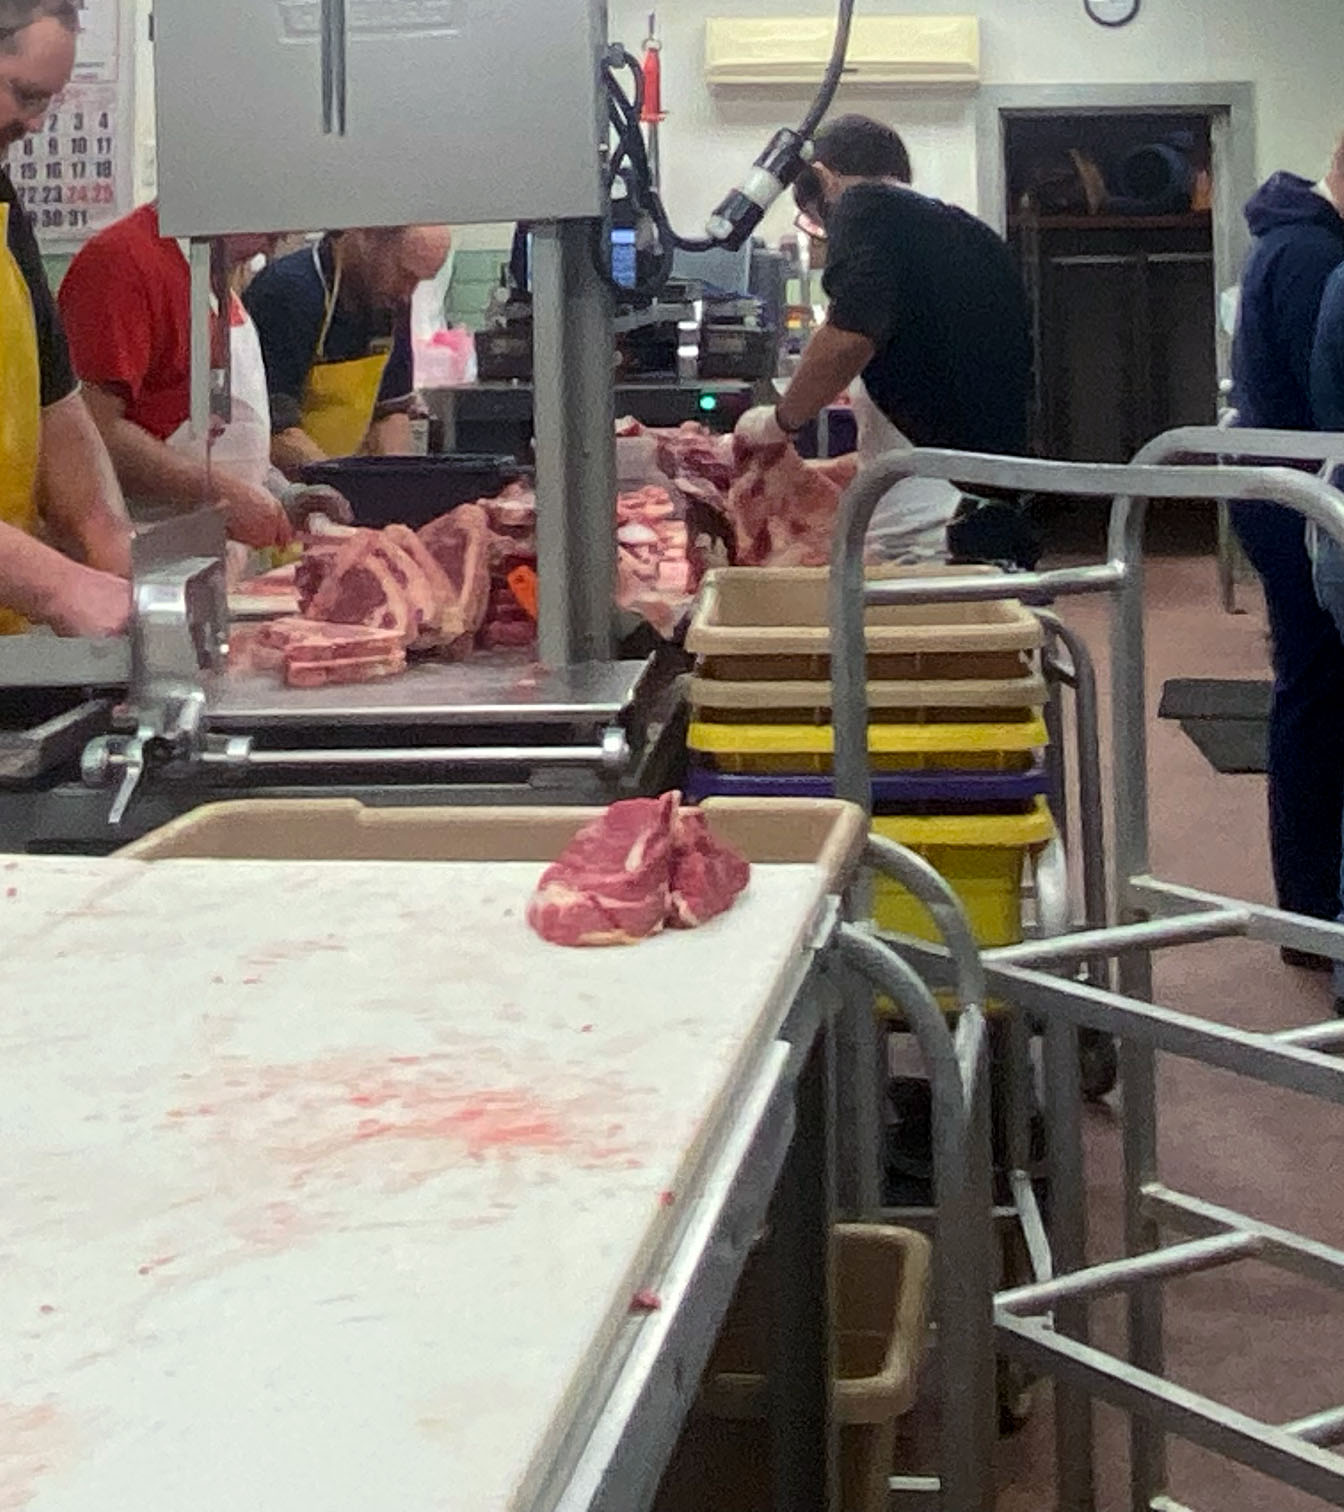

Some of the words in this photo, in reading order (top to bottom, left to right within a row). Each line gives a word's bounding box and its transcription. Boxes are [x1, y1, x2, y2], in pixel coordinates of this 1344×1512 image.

[49, 113, 58, 132] 2
[73, 112, 83, 130] 3
[99, 112, 109, 129] 4
[71, 136, 87, 155] 10
[97, 136, 112, 155] 11
[45, 161, 62, 179] 16
[71, 160, 87, 179] 17
[96, 160, 112, 179] 18
[42, 209, 63, 227] 30
[68, 209, 88, 227] 31
